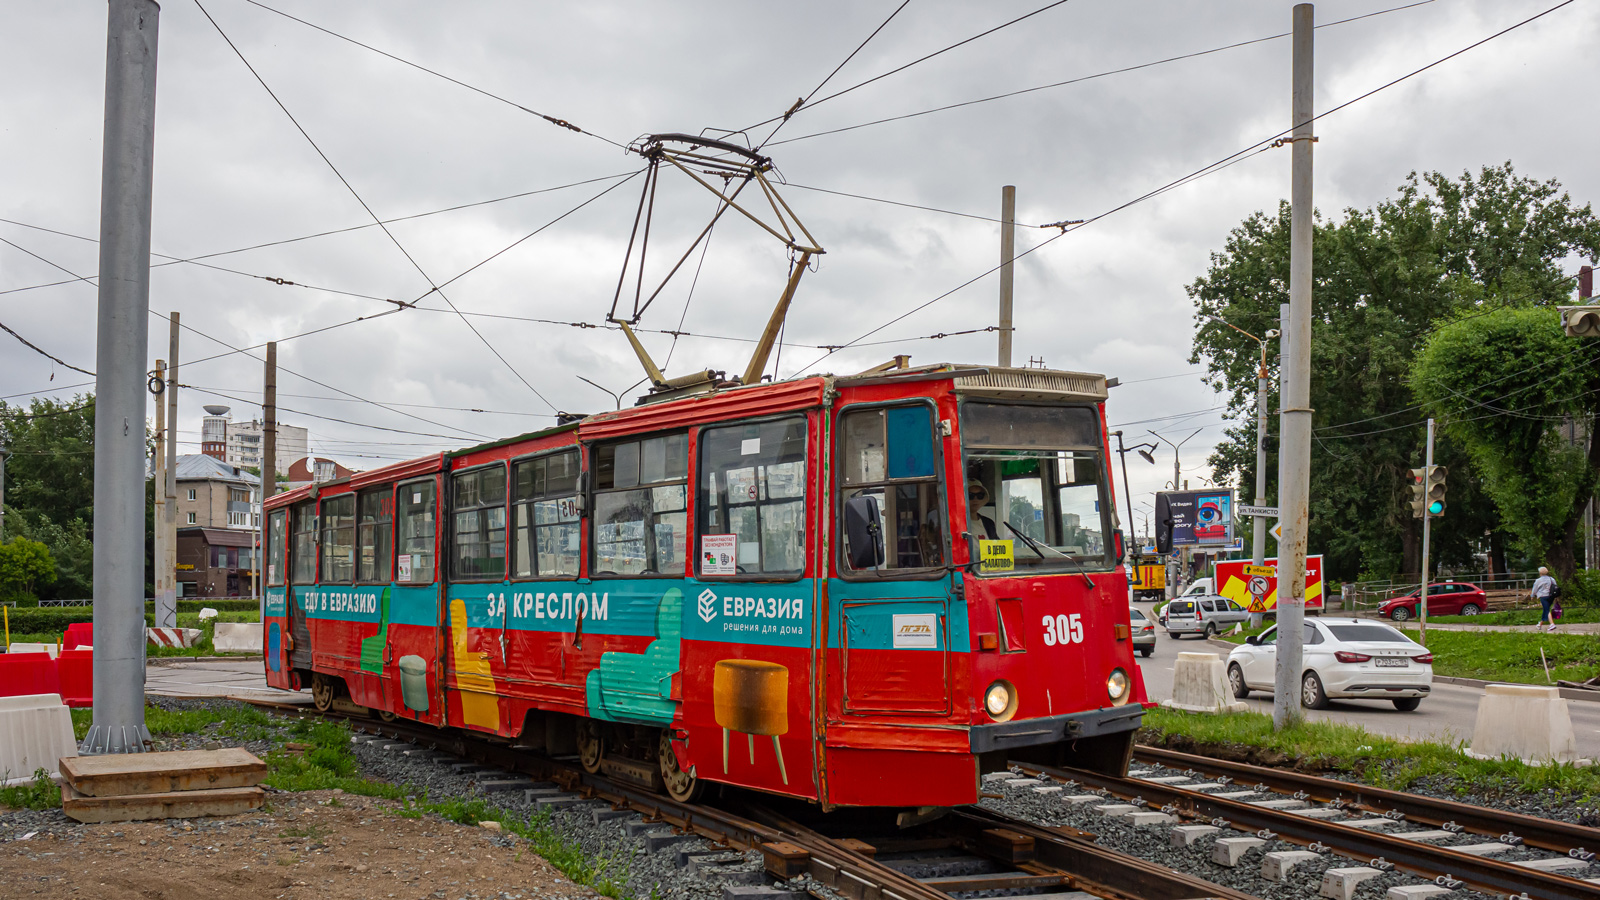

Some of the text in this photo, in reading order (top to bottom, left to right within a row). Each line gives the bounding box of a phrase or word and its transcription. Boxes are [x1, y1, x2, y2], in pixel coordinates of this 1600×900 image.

[987, 545, 1006, 556] В ДЕПО
[304, 592, 377, 614] ЕДУ В ЕВРАЗИЮ
[487, 592, 609, 621] ЗА КРЕСЛОМ
[723, 596, 804, 620] ЕВРАЗИЯ
[723, 622, 803, 636] решения для дома
[1042, 613, 1084, 646] 305
